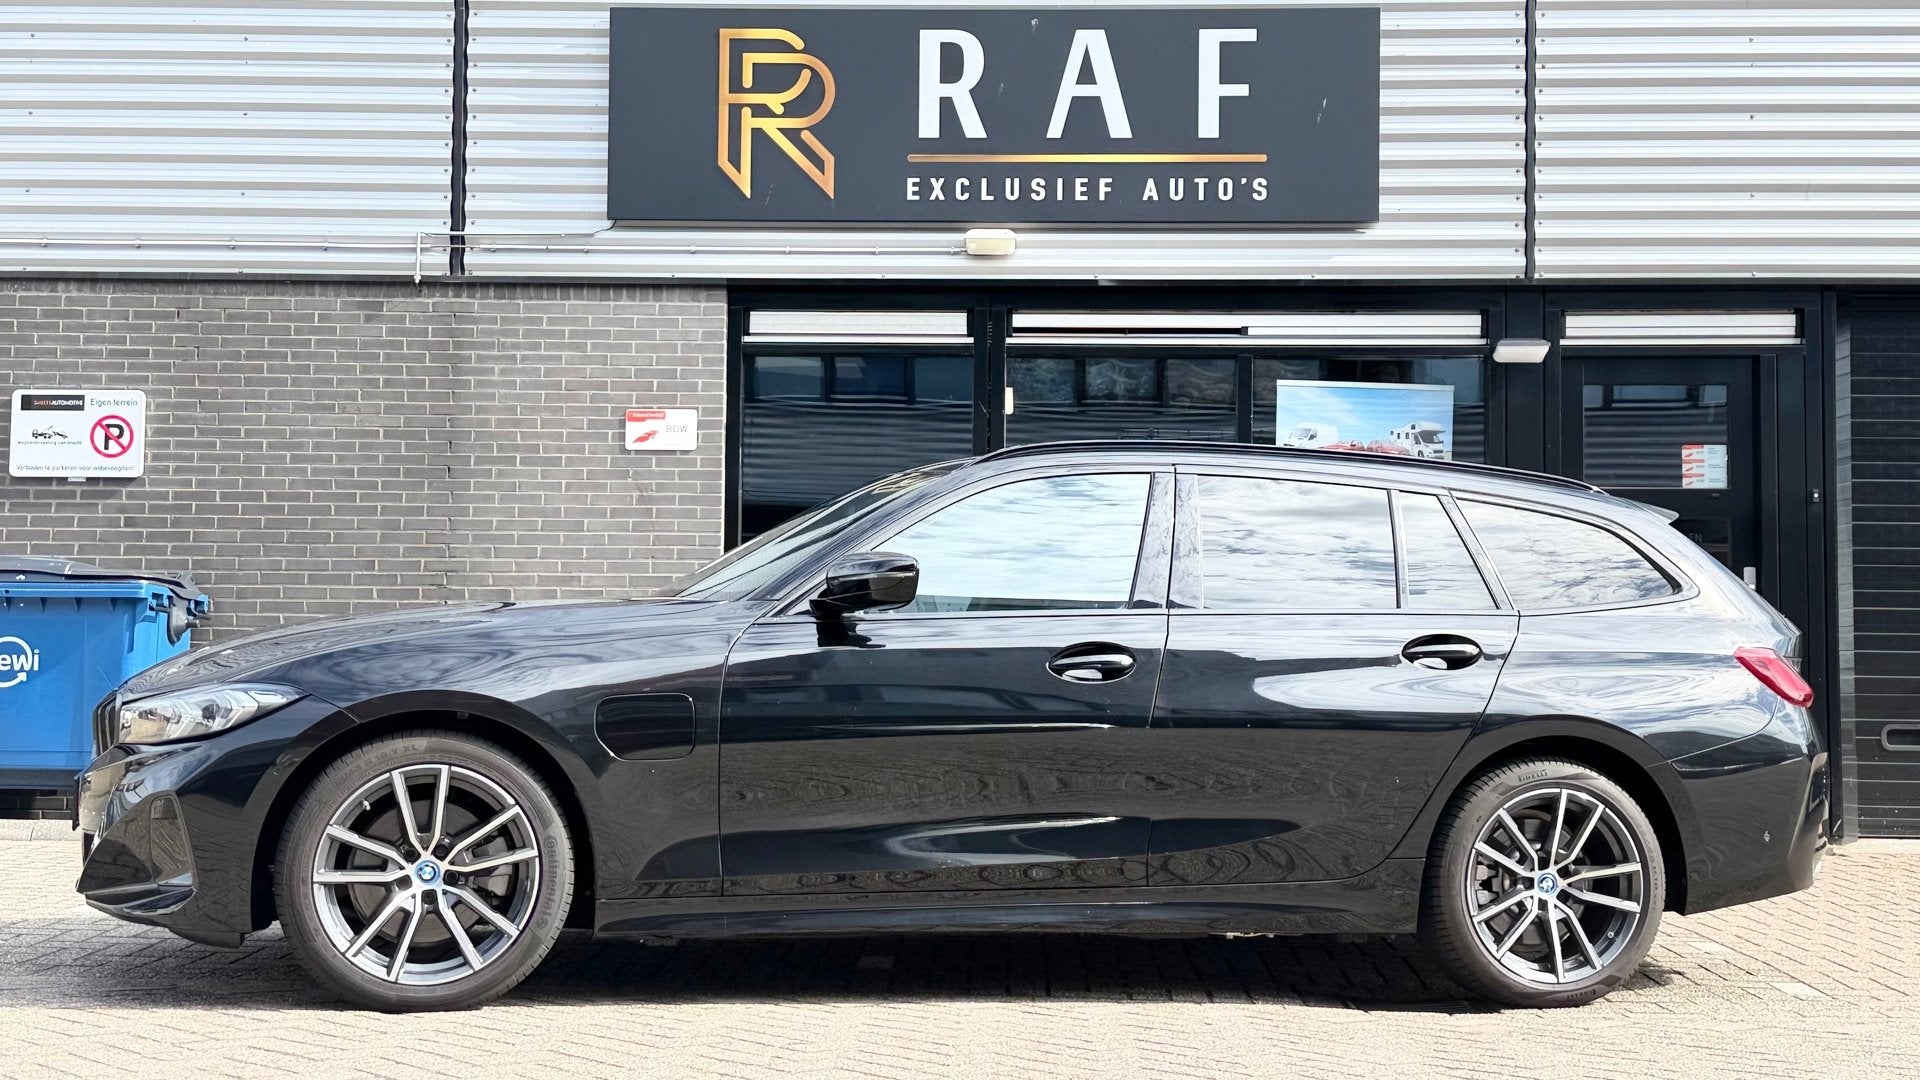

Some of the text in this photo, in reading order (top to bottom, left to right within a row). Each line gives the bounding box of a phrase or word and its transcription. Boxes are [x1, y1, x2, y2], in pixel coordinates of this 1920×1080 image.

[918, 28, 1258, 139] RAF
[907, 177, 1269, 201] EXCLUSIEF AUTO'S
[90, 398, 138, 407] Eigen terrein
